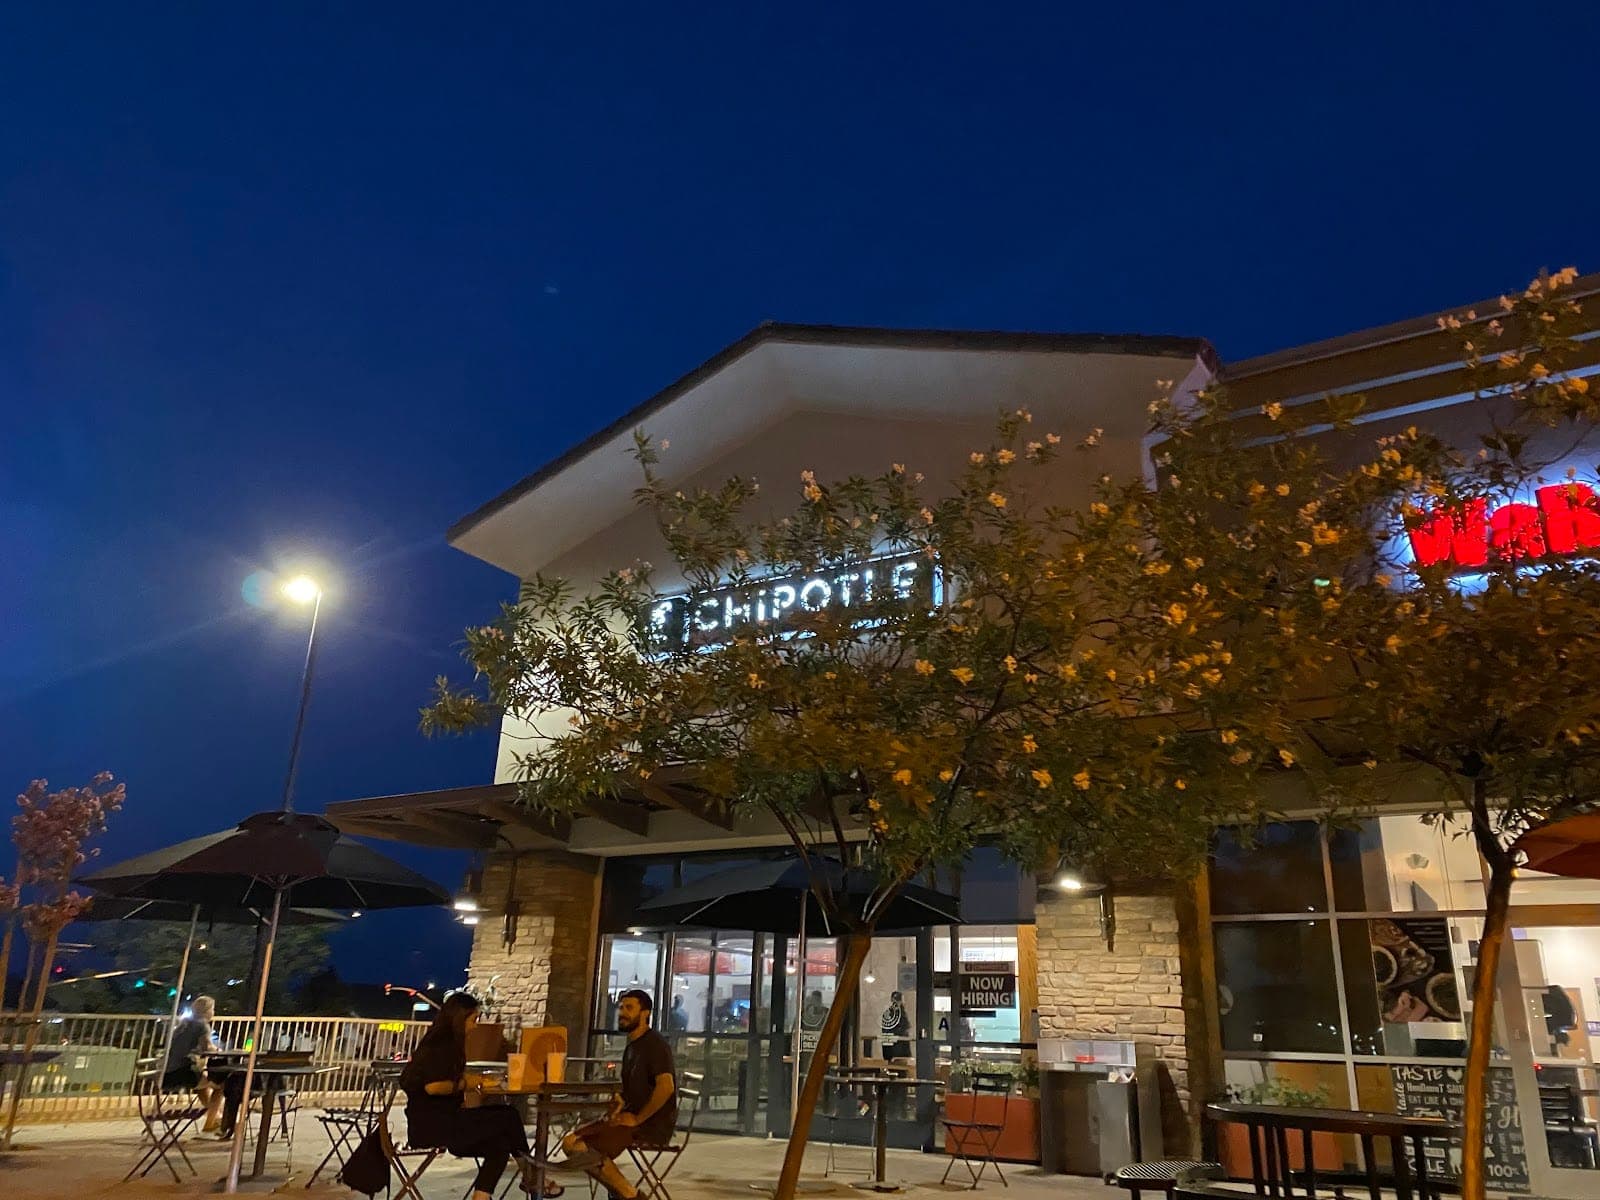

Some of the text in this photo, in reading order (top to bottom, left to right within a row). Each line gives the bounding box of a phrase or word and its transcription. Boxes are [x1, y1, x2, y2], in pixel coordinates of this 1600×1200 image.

[969, 976, 1005, 991] NOW
[961, 991, 1014, 1006] HIRING!
[938, 1017, 949, 1031] A
[1391, 1065, 1444, 1081] TASTE
